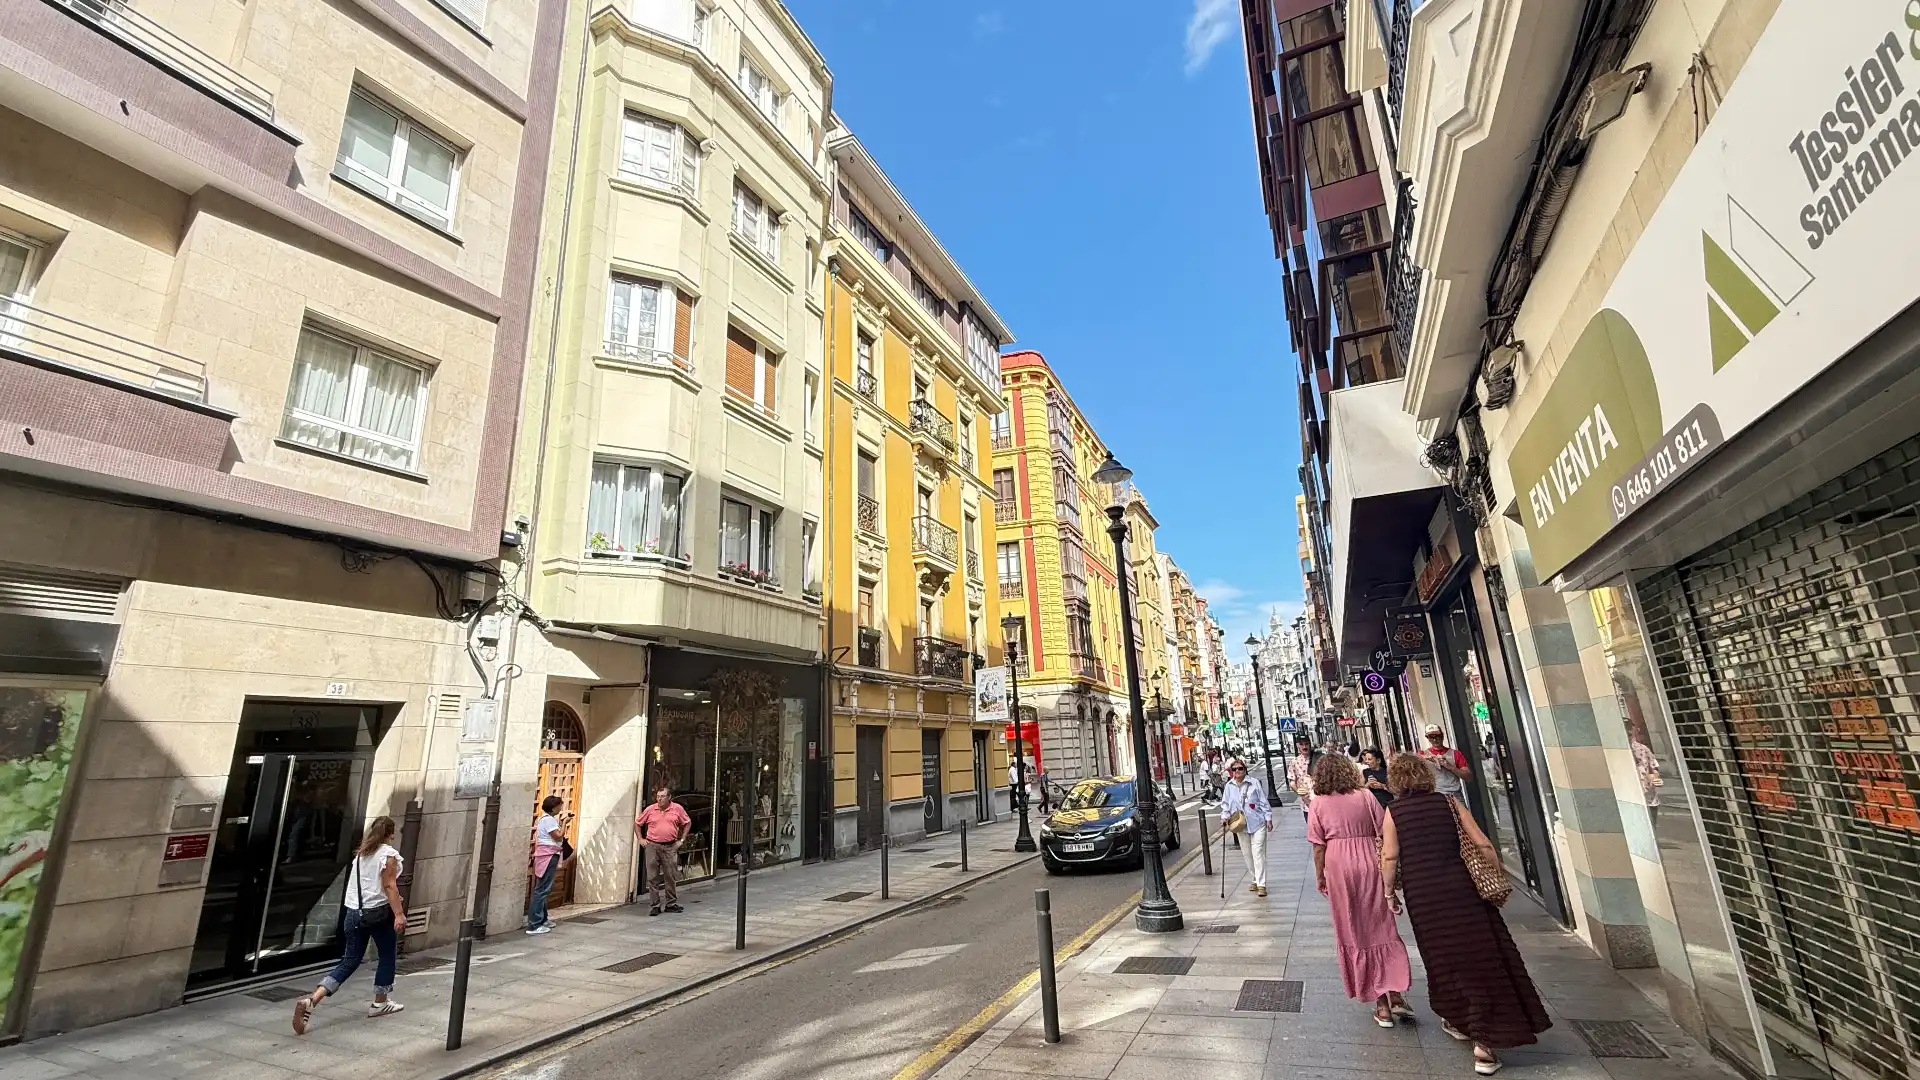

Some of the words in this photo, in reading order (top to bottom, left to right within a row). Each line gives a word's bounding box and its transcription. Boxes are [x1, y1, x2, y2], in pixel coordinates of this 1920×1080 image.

[1788, 31, 1905, 194] Tessier
[1799, 89, 1920, 250] santama
[1528, 474, 1555, 529] EN
[1549, 402, 1619, 505] VENTA
[1626, 468, 1651, 505] 646
[1649, 445, 1677, 486] 101
[1674, 418, 1709, 463] 811
[331, 683, 343, 695] 38
[546, 728, 557, 740] 36
